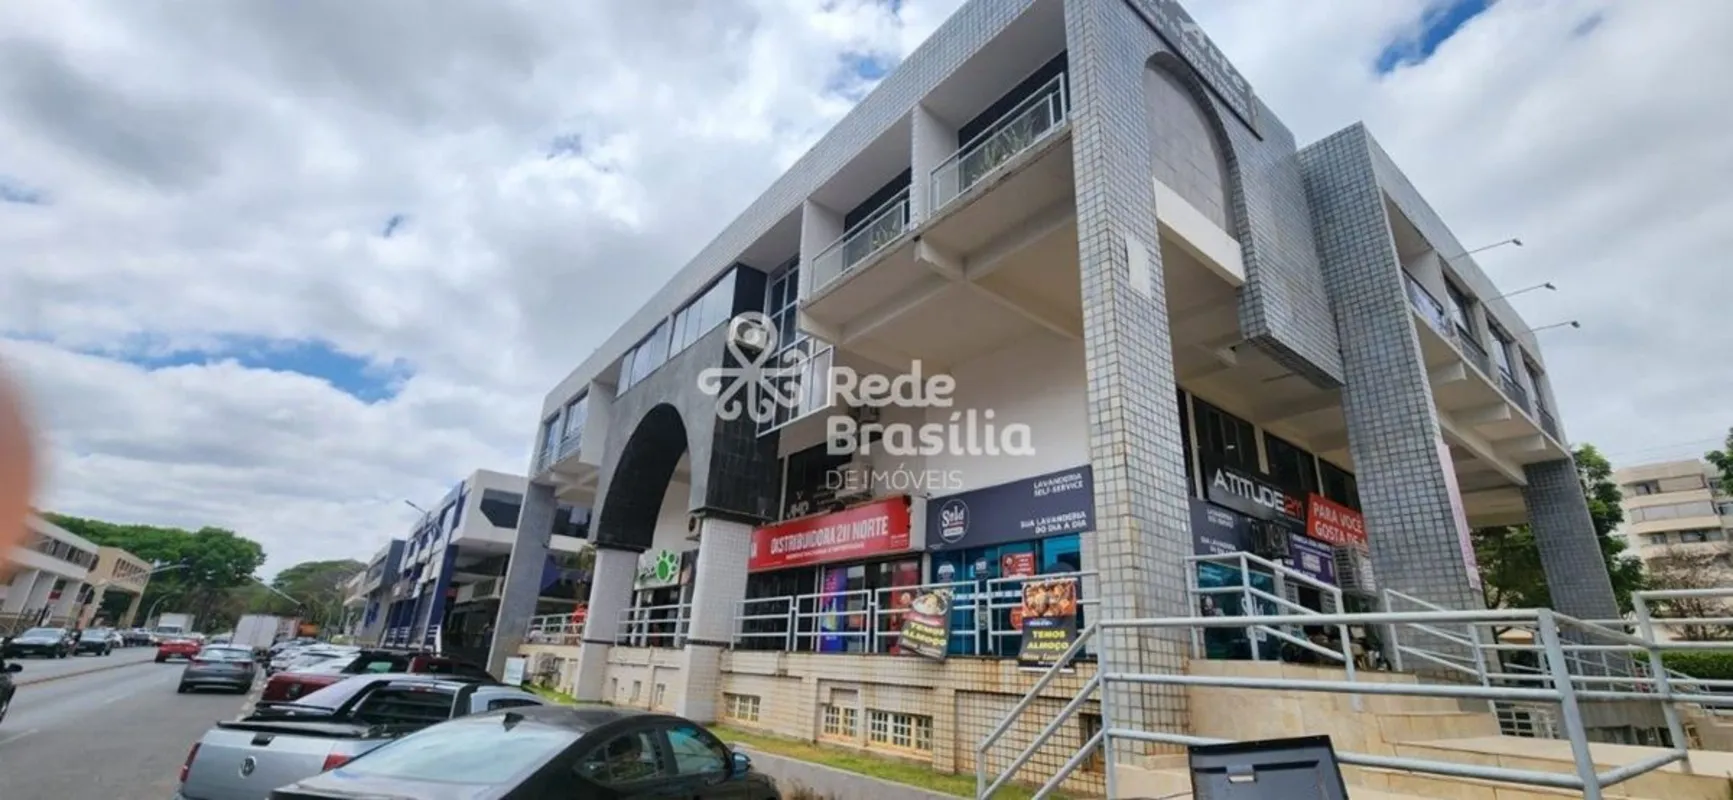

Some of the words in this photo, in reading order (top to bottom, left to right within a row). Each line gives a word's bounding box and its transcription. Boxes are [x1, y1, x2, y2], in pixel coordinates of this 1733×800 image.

[1033, 472, 1082, 489] LAVANDERIA
[1036, 511, 1087, 526] LAVANDERIA
[1313, 501, 1338, 523] PARA
[770, 527, 836, 554] DISTRIBUIDORA
[852, 516, 889, 539] NORTE
[1035, 525, 1047, 534] DO
[1064, 522, 1071, 530] A
[1315, 520, 1345, 543] GOSTA
[1032, 630, 1065, 639] TEMOS
[1026, 641, 1069, 651] ALMOÇO
